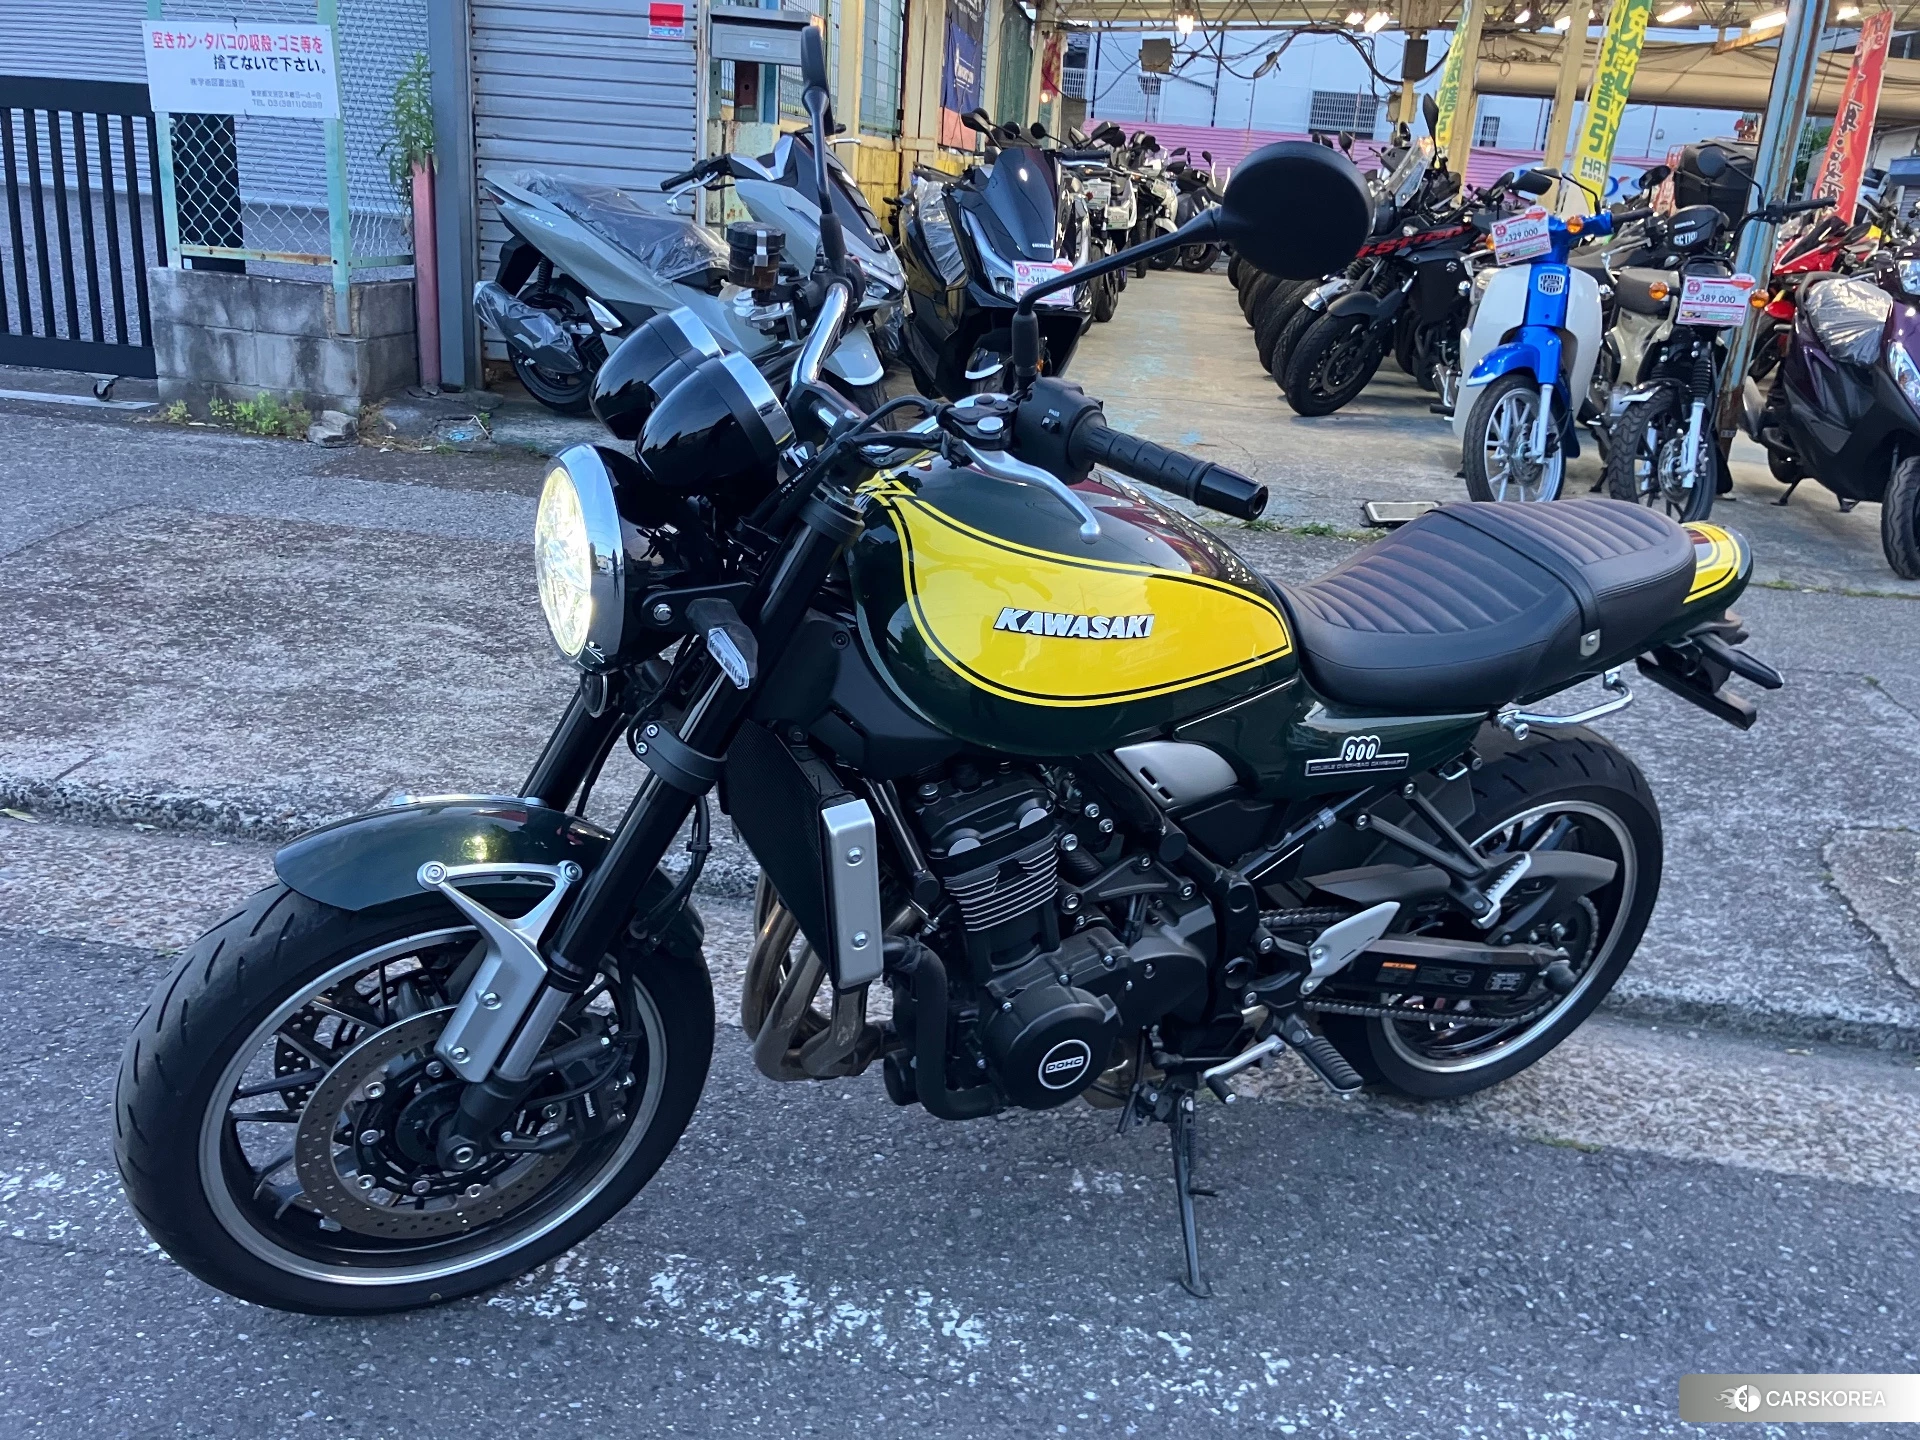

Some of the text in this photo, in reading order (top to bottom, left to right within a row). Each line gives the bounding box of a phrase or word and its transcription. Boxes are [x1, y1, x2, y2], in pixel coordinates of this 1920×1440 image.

[213, 54, 326, 74] 捨てないで下さい。
[993, 607, 1155, 640] KAWASAKI
[1345, 743, 1376, 762] 900
[1047, 1058, 1083, 1072] DOHC
